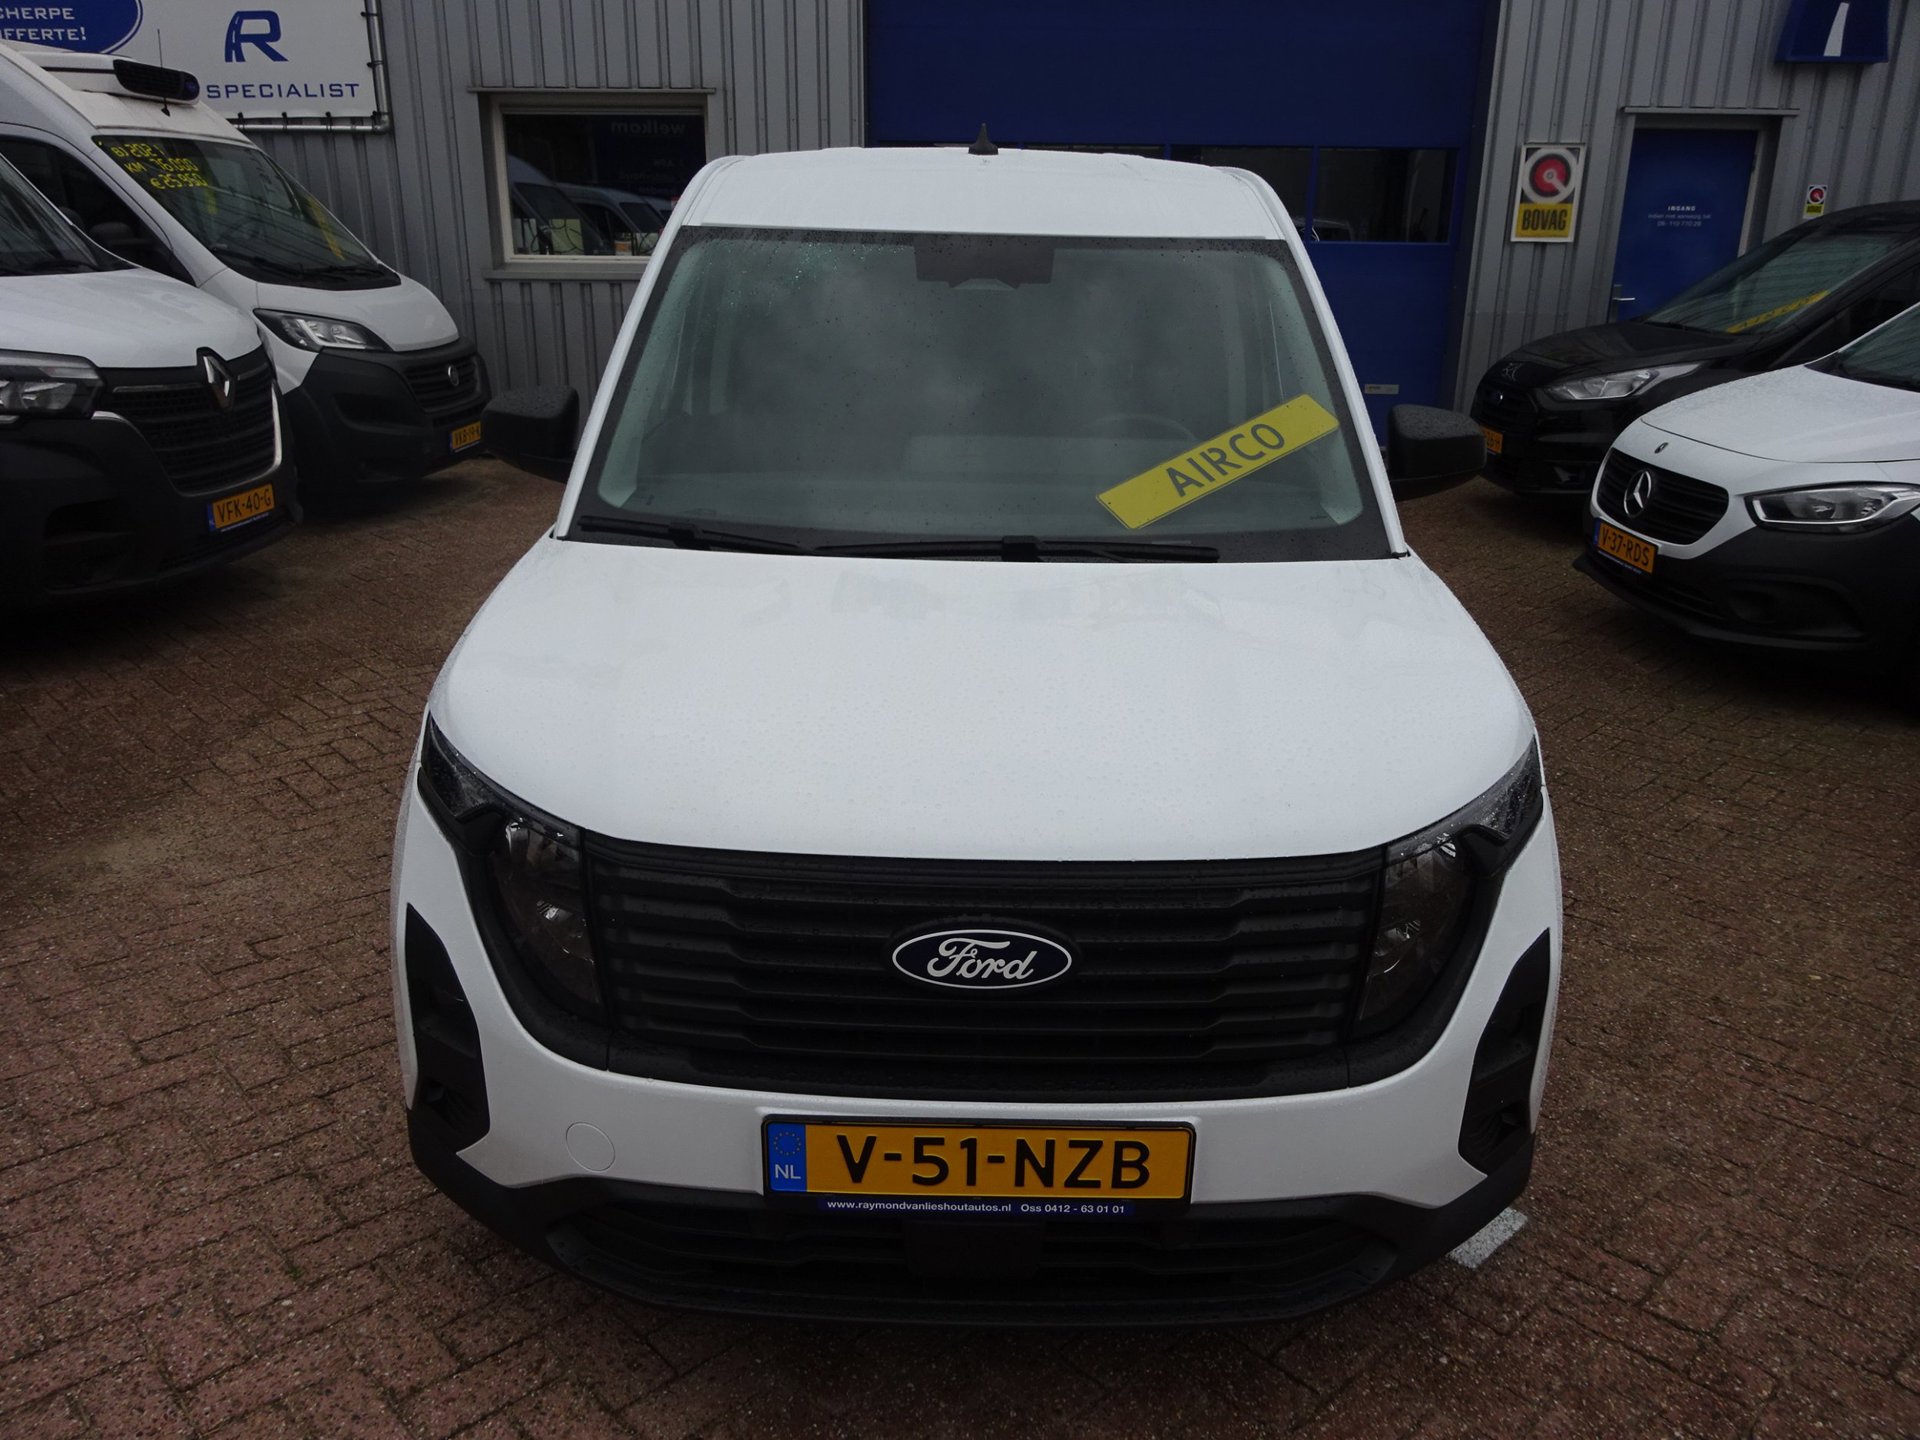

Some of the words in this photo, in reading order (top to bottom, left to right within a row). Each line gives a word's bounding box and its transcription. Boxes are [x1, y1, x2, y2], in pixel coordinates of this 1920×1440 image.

[0, 26, 87, 41] FFERTE!
[207, 83, 360, 99] SPECIALIST
[124, 161, 148, 173] KM
[1521, 209, 1568, 231] BOVAG
[1165, 423, 1285, 498] AIRCO
[217, 488, 272, 523] VFK-40-G
[1602, 526, 1650, 566] V-37-RDS
[927, 937, 1038, 980] Ford
[774, 1164, 801, 1180] NL
[836, 1134, 1151, 1189] V-51-NZB
[827, 1200, 1011, 1213] www.raymondvanlieshoutautos.nl
[1020, 1204, 1042, 1213] Oss
[1044, 1204, 1070, 1213] 0412
[1080, 1204, 1095, 1214] 63
[1096, 1204, 1110, 1214] 01
[1112, 1204, 1126, 1214] 01
